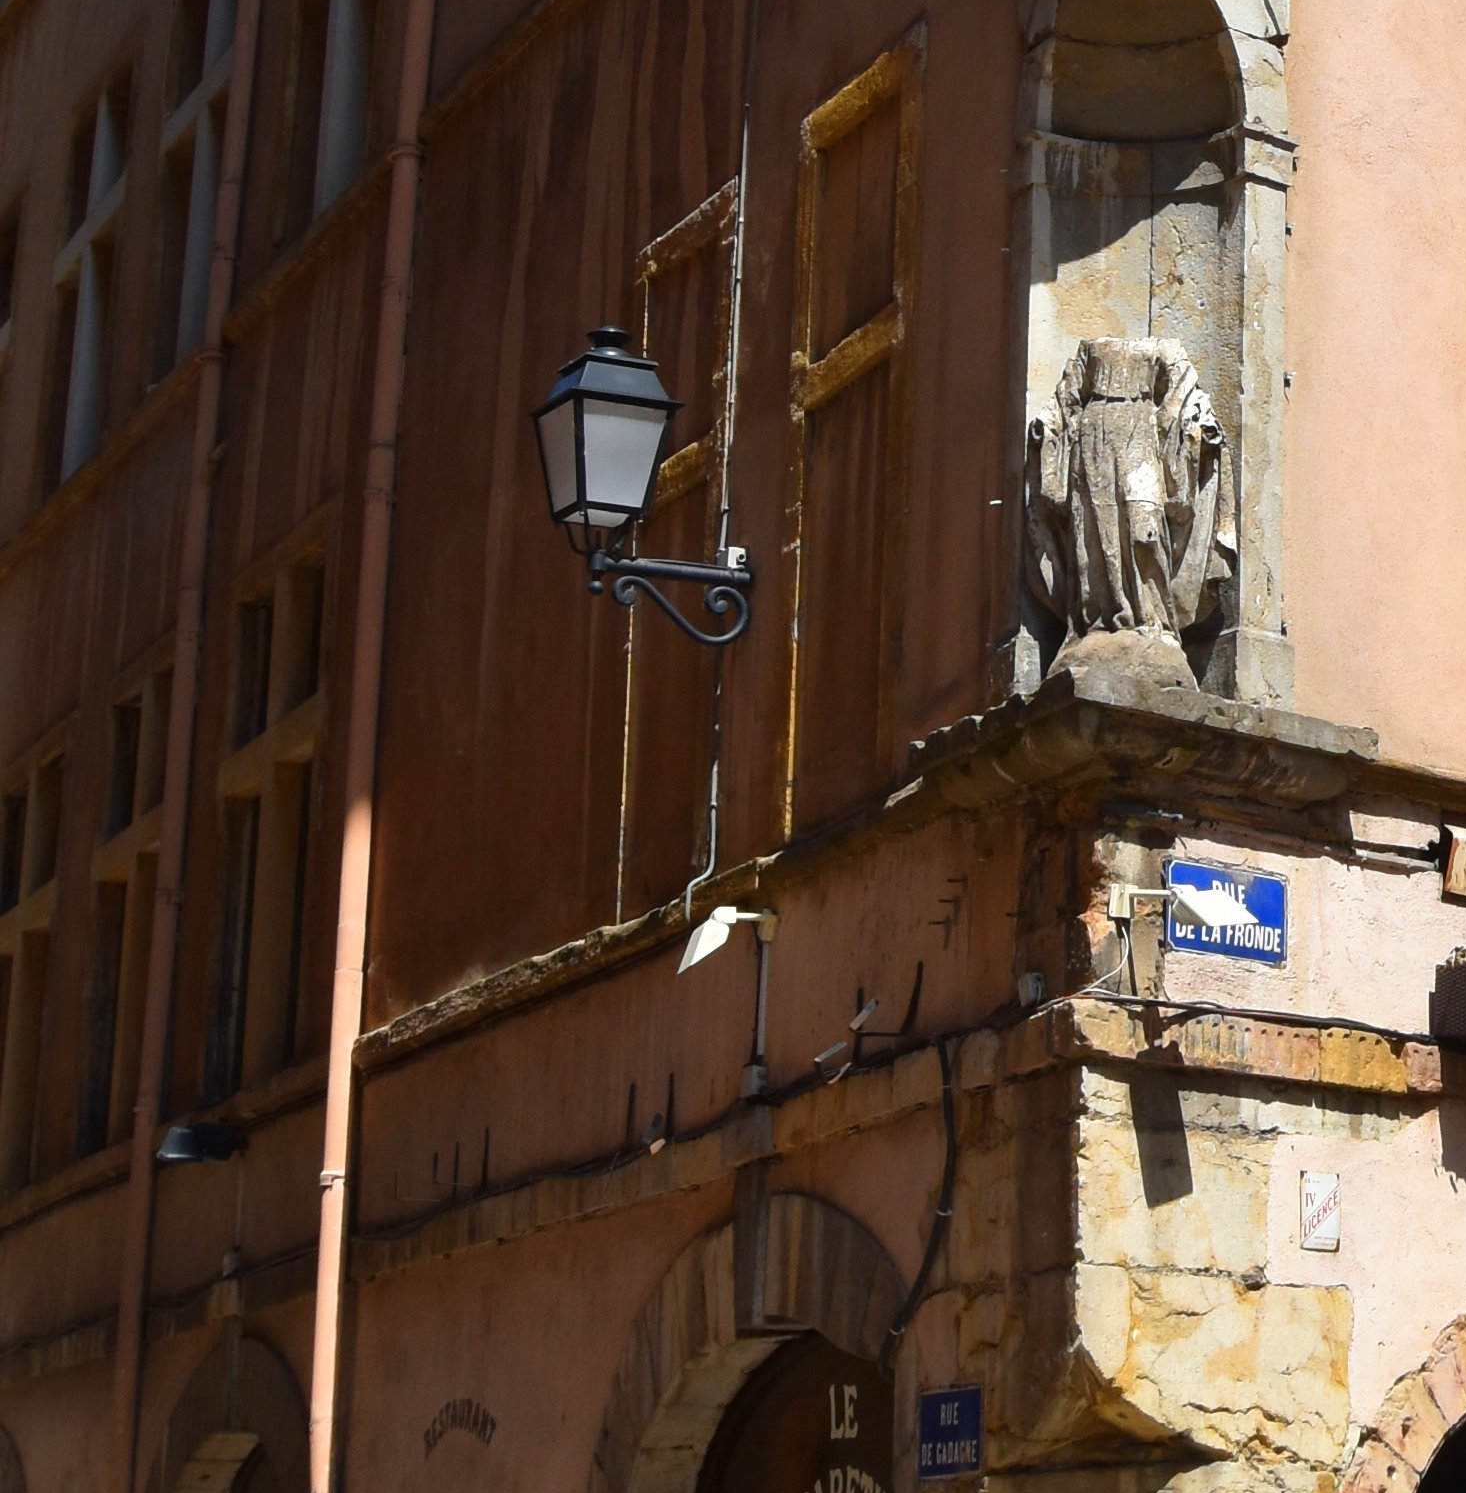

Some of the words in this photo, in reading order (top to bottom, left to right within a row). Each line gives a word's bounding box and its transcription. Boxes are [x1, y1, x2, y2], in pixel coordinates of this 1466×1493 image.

[1226, 924, 1281, 953] FRONDE
[1303, 1190, 1338, 1238] LICENCE
[1304, 1192, 1316, 1207] IV
[829, 1383, 859, 1439] LE
[940, 1402, 959, 1426] RUE
[423, 1398, 496, 1460] RESTAURANT
[922, 1443, 933, 1466] DE
[936, 1440, 977, 1464] GADAGNE
